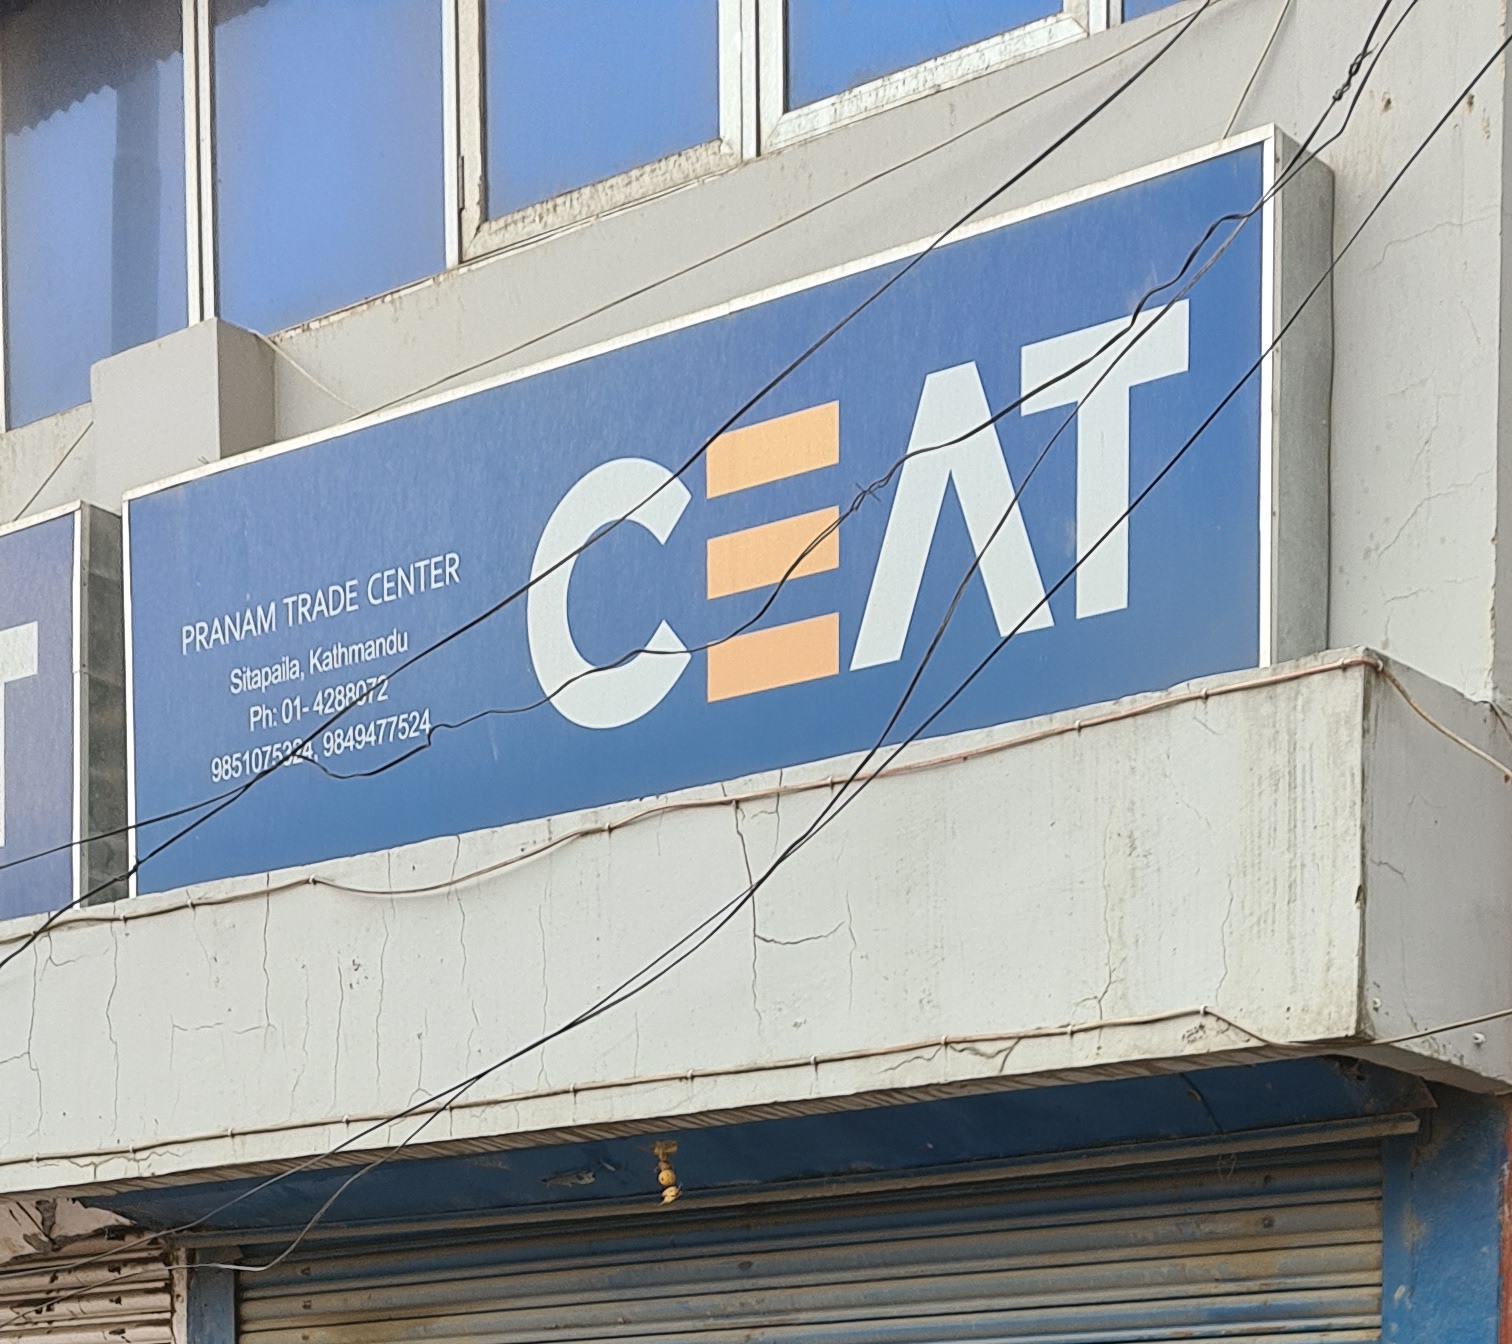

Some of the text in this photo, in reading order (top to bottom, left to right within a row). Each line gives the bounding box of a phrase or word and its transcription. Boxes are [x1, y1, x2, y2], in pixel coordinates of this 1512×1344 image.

[528, 299, 1189, 728] CEAT
[182, 552, 460, 655] PRANAM TRADE CENTER
[230, 628, 408, 694] Sitapaila, Kathmandu
[250, 704, 277, 732] Ph:
[323, 708, 431, 758] 9849477524
